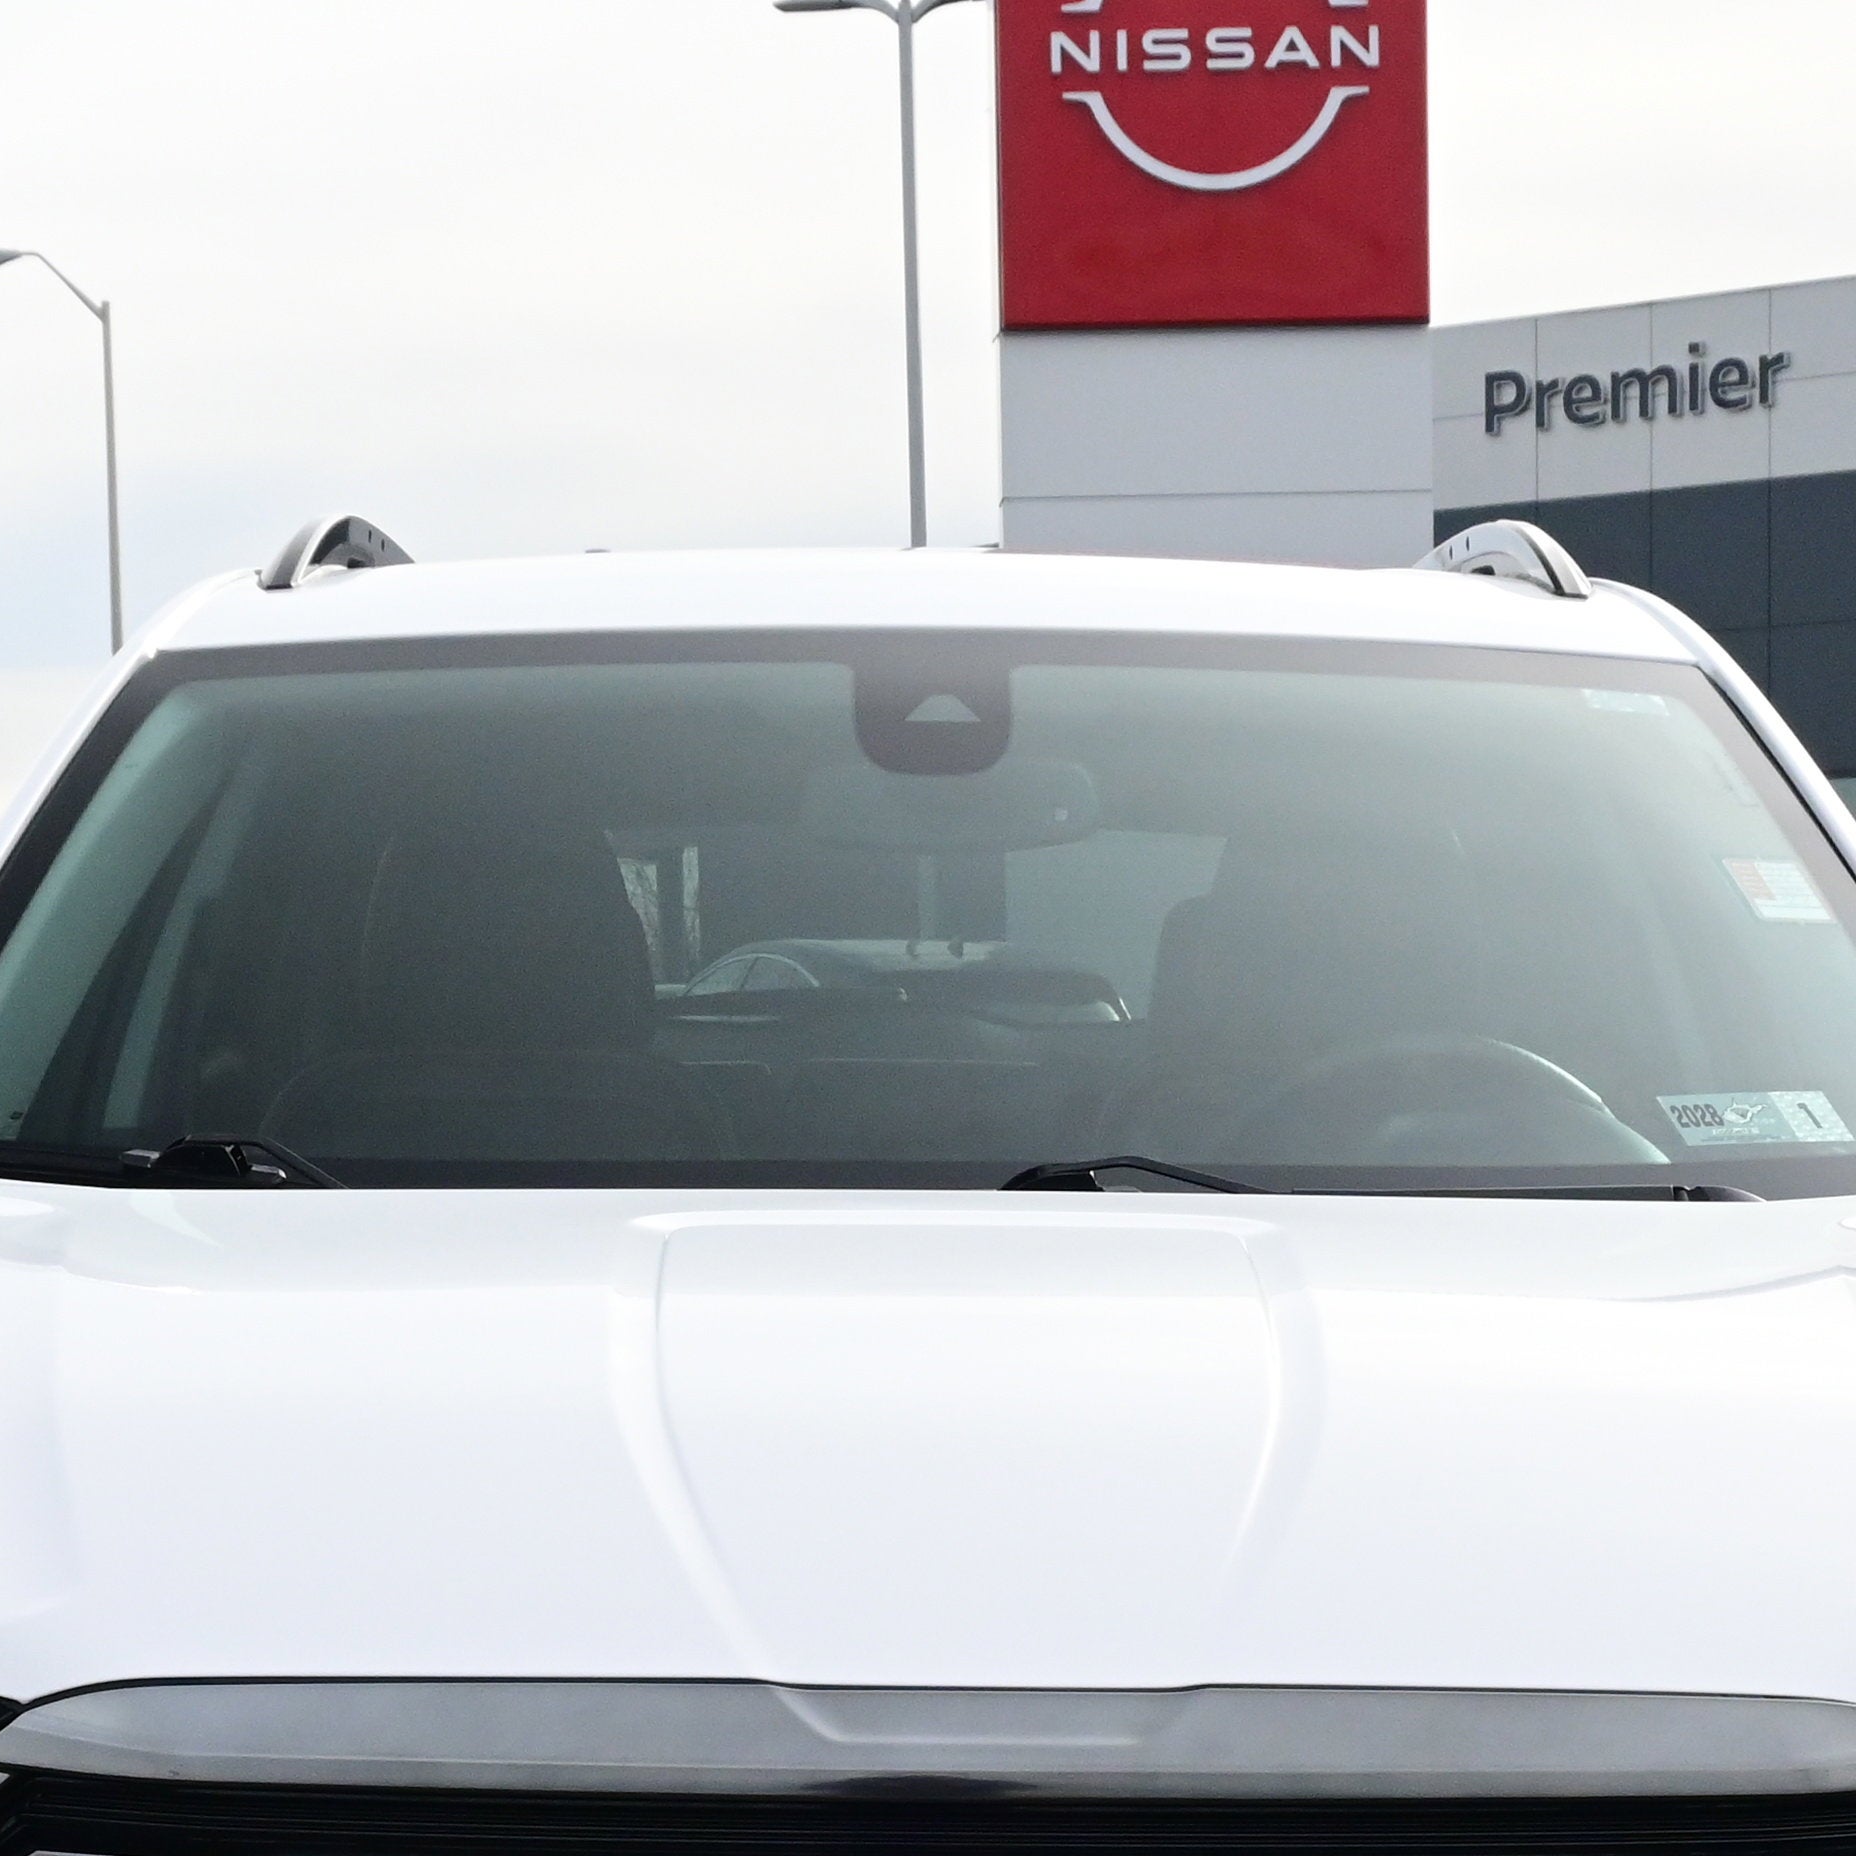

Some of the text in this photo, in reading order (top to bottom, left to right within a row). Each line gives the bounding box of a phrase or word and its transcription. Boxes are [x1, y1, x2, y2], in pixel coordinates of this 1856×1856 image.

[1049, 24, 1381, 75] NISSAN
[1484, 341, 1792, 437] Premier
[1669, 1102, 1824, 1130] 2028 1
